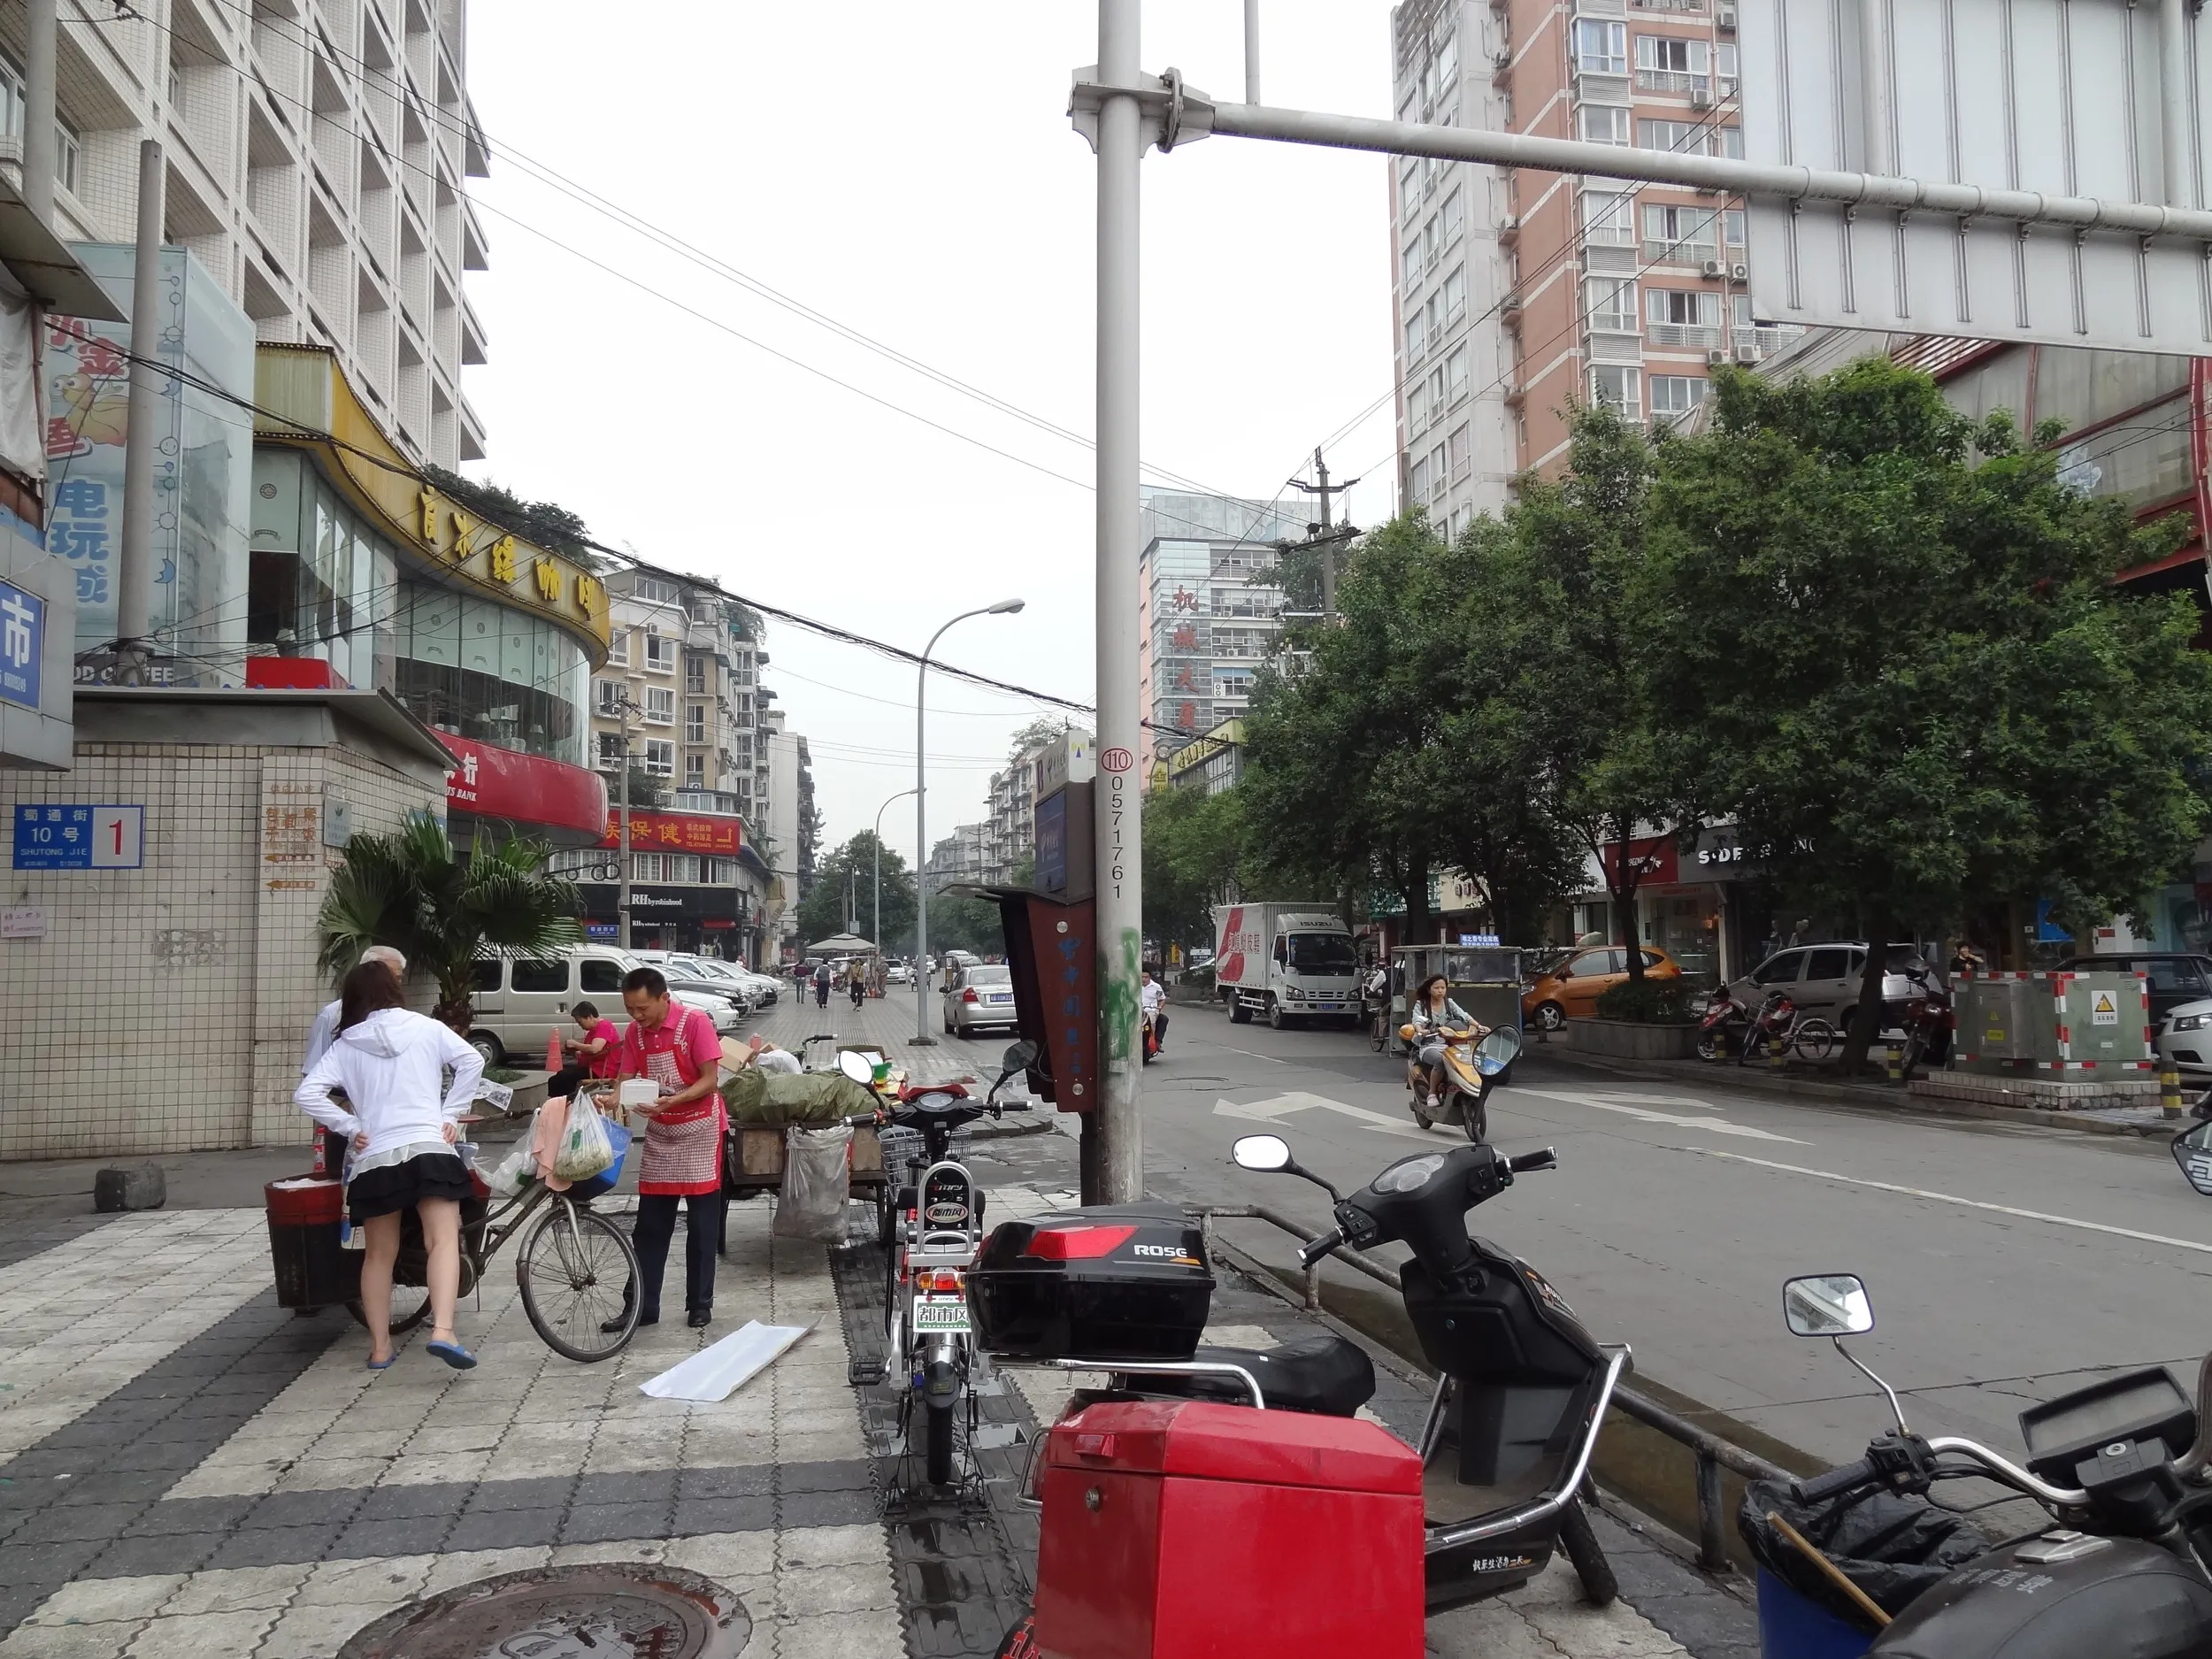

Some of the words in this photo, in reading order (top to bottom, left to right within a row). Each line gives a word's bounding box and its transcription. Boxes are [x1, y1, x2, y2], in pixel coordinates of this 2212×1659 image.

[1173, 584, 1200, 729] 机械大厦
[1106, 751, 1128, 769] 110
[457, 788, 477, 802] BANK
[24, 809, 87, 821] 蜀通街
[31, 827, 80, 842] 10号
[109, 819, 122, 855] 1
[1111, 776, 1124, 899] 0571761
[932, 1208, 964, 1217] 都市风
[1133, 1244, 1188, 1258] ROSE
[918, 1306, 969, 1323] 都市风
